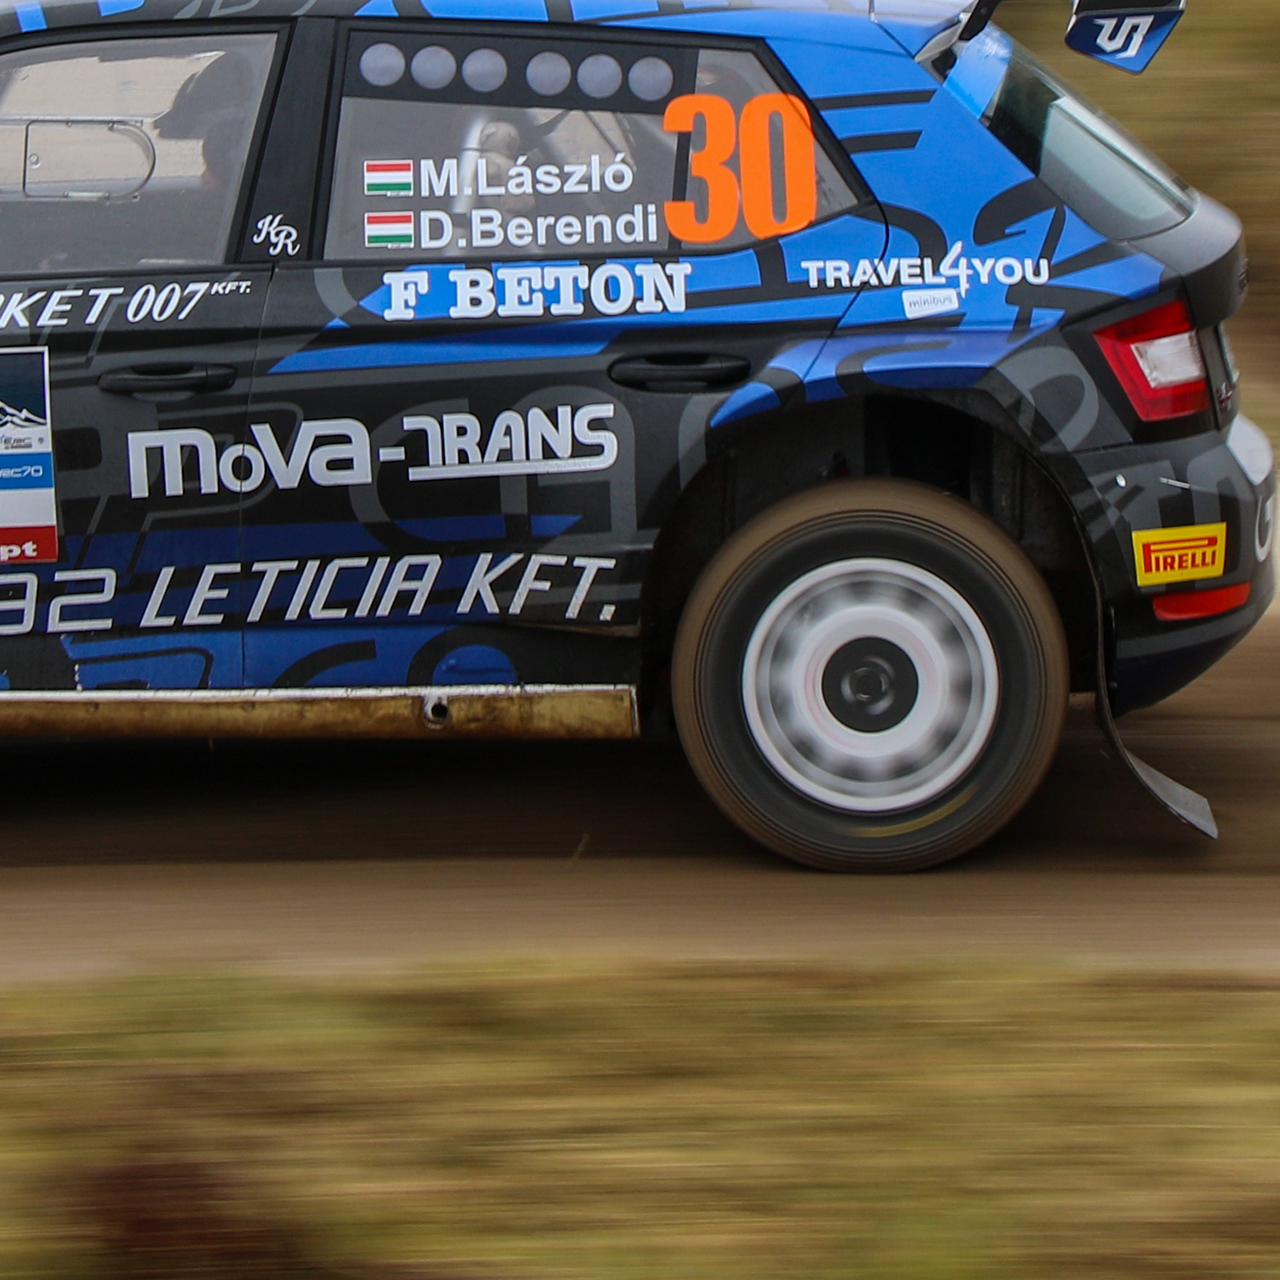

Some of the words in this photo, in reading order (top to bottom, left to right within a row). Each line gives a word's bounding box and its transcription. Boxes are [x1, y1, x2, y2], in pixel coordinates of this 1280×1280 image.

[419, 152, 634, 198] M.László
[663, 92, 818, 243] 30
[419, 203, 658, 250] D.Berendi
[382, 269, 430, 321] F
[447, 262, 692, 320] BETON
[800, 240, 1050, 299] TRAVEL4YOU
[125, 280, 210, 323] 007
[210, 279, 252, 296] KFT.
[908, 293, 954, 309] minibus
[1142, 535, 1218, 573] PIRELLI
[139, 553, 443, 629] LETICIA
[456, 552, 617, 621] KFT.
